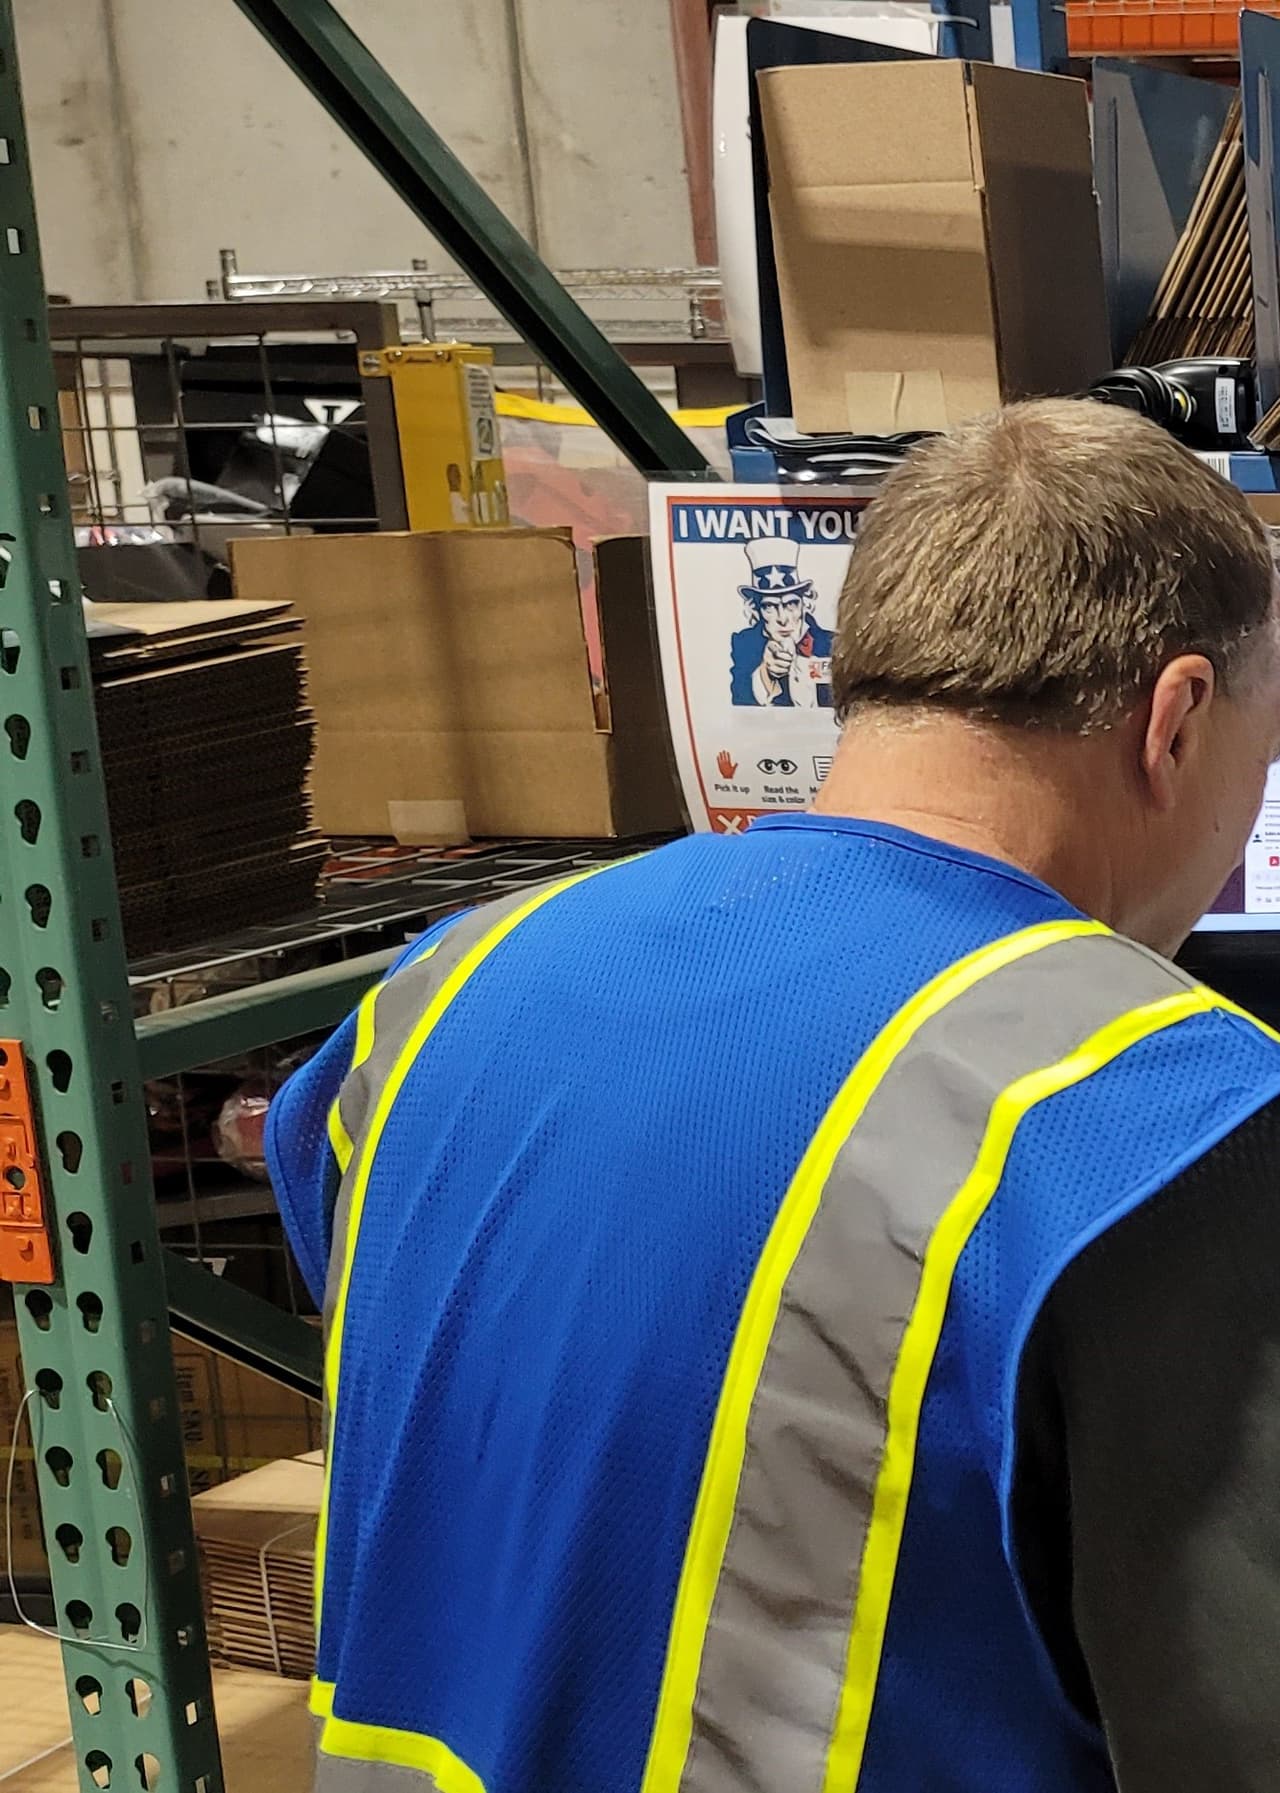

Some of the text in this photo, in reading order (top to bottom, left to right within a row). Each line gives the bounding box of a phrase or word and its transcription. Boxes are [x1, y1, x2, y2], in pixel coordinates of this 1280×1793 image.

[679, 509, 689, 538] I
[695, 509, 793, 538] WANT
[785, 786, 800, 794] the
